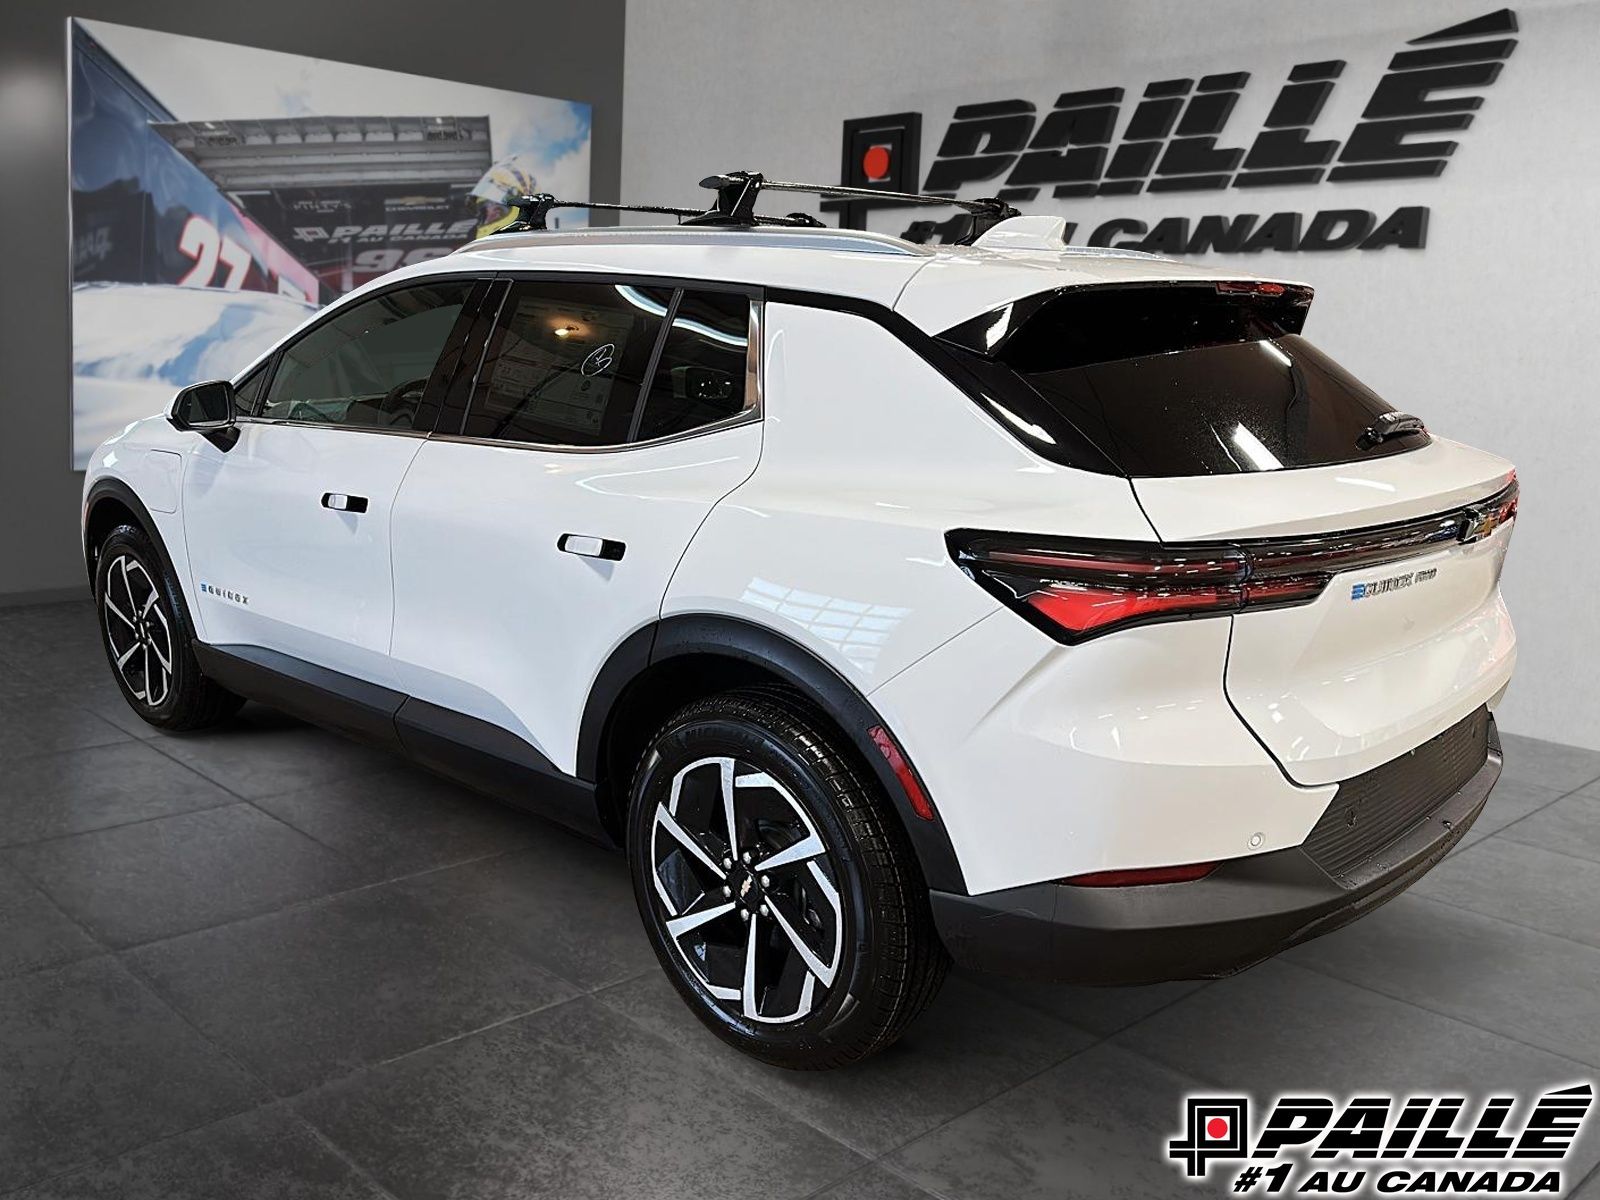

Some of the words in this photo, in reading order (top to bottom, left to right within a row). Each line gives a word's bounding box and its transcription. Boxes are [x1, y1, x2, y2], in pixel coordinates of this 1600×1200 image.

[923, 9, 1518, 201] PAILLÉ
[177, 213, 252, 291] 27
[1085, 206, 1429, 253] CANADA
